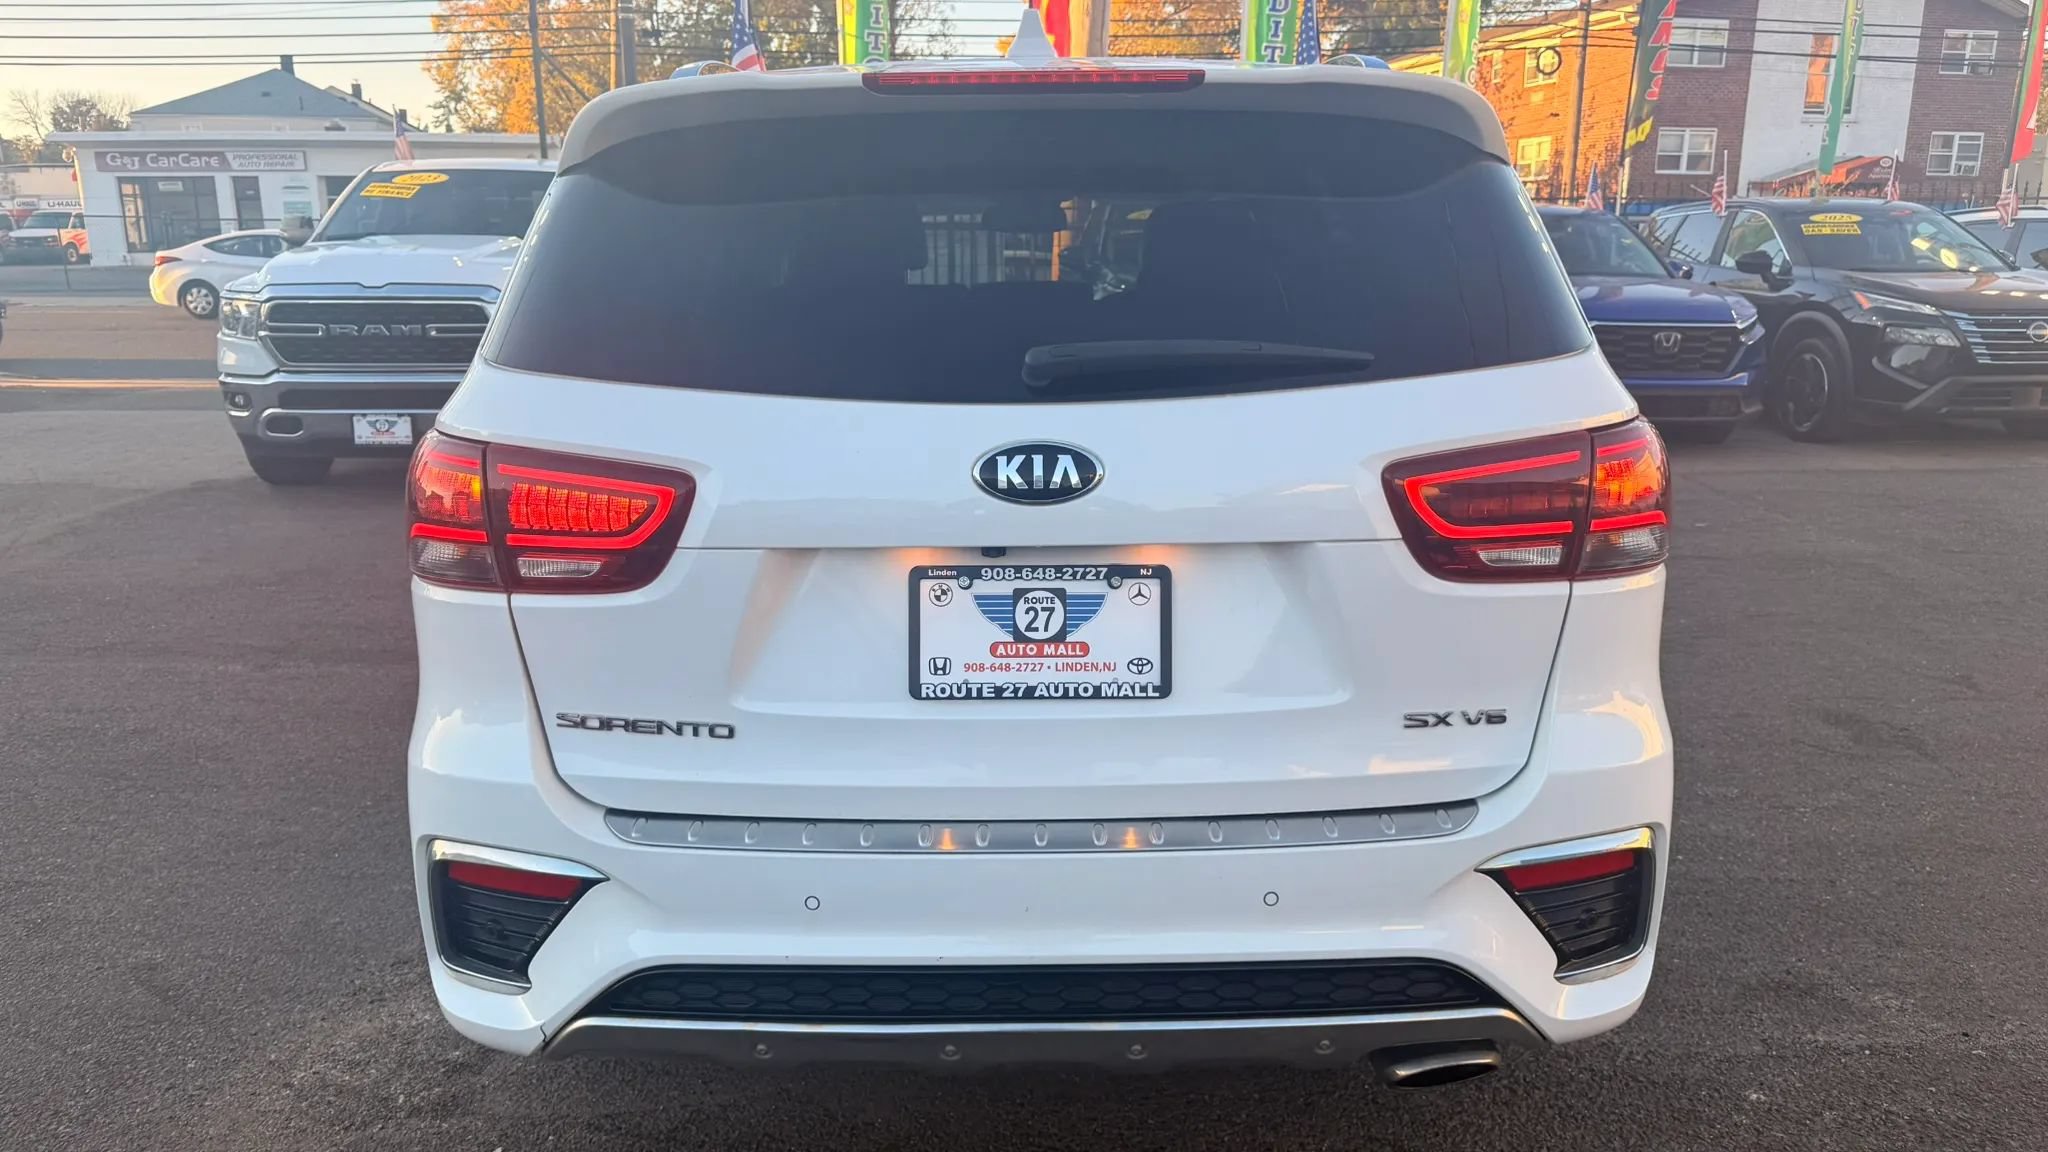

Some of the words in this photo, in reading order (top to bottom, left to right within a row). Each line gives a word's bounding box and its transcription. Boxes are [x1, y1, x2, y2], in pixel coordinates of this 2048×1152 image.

[106, 152, 140, 169] G&J
[146, 153, 220, 168] CarCare
[231, 152, 299, 161] PROFESSIONAL
[238, 160, 265, 168] AUTO
[268, 160, 296, 168] REPAIR
[329, 324, 421, 336] RAM
[995, 454, 1082, 489] KIA
[928, 569, 957, 577] Linden
[981, 567, 1108, 581] 908-648-2727
[1140, 568, 1153, 576] NJ
[1023, 596, 1056, 605] ROUTE
[1024, 606, 1056, 633] 27
[996, 644, 1037, 656] AUTO
[1043, 644, 1084, 656] MALL
[963, 662, 1044, 673] 908-648-2727
[920, 682, 995, 698] ROUTE
[1002, 682, 1028, 698] 27
[1034, 682, 1094, 698] AUTO
[1101, 682, 1160, 698] MALL
[1403, 711, 1454, 729] SX
[1460, 708, 1507, 726] V6
[556, 712, 736, 740] SORENTO
